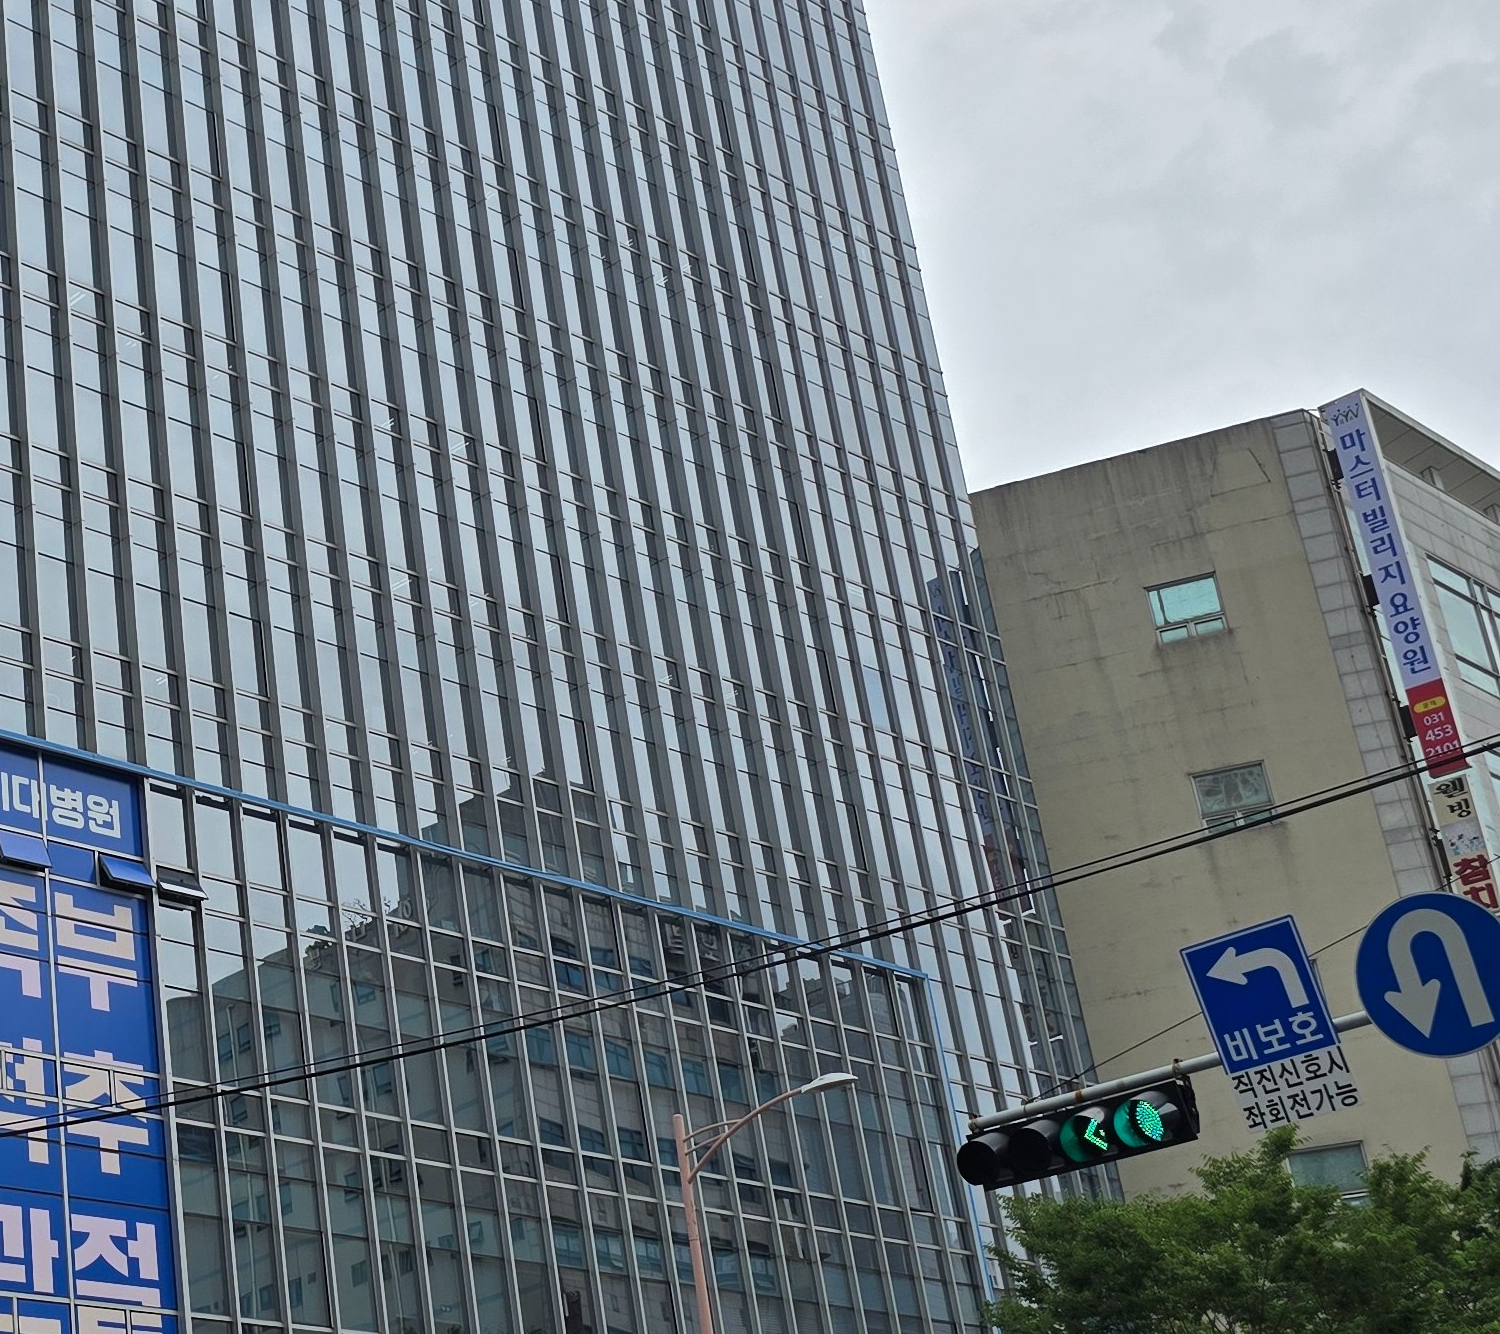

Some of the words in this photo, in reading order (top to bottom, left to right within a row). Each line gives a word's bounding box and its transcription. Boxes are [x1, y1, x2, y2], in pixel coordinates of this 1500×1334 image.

[1339, 428, 1432, 676] 마스터빌리지요양원
[1423, 711, 1445, 726] 031
[1425, 724, 1454, 741] 453
[1434, 776, 1472, 818] 웰빙
[1452, 854, 1499, 909] 참치
[1223, 1011, 1324, 1062] 비보호
[1231, 1045, 1350, 1099] 직진신호시
[1242, 1080, 1359, 1130] 좌회전가능
